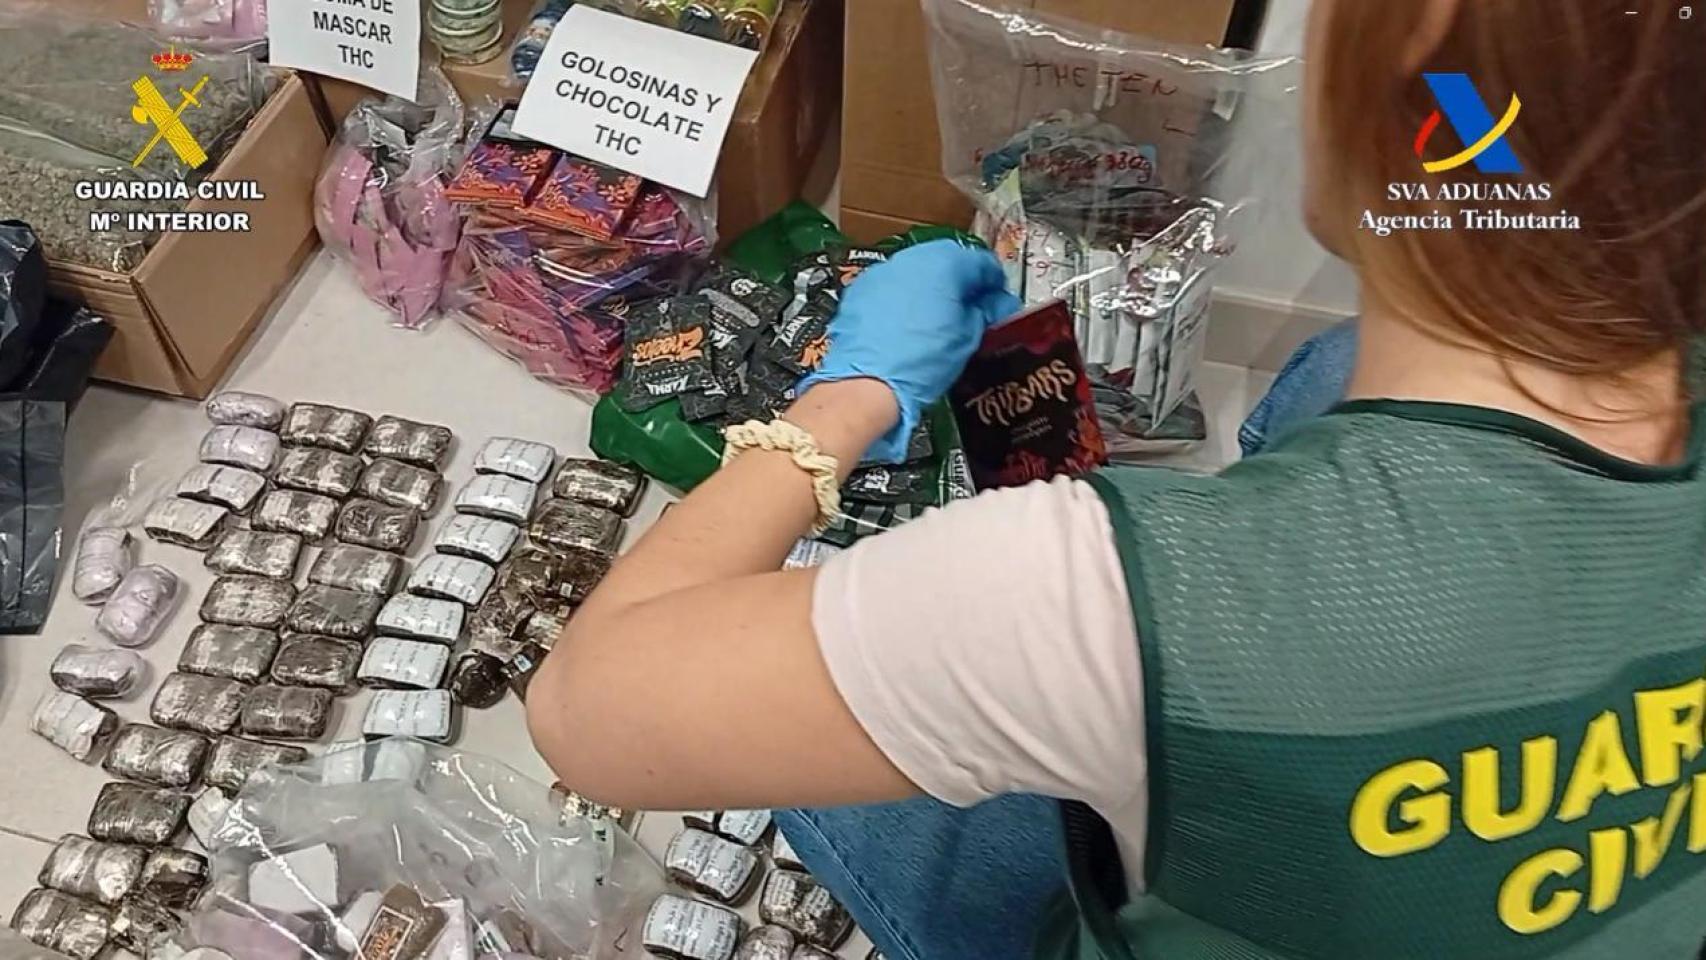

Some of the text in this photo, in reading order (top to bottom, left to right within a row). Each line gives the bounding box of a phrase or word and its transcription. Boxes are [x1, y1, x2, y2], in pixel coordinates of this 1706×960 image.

[313, 11, 392, 44] MASCAR
[338, 44, 375, 69] THC
[561, 51, 723, 113] GOLOSINAS Y
[1023, 62, 1087, 88] THE
[555, 79, 705, 142] CHOCOLATE
[594, 124, 642, 155] THC
[1349, 677, 1706, 858] GUAR
